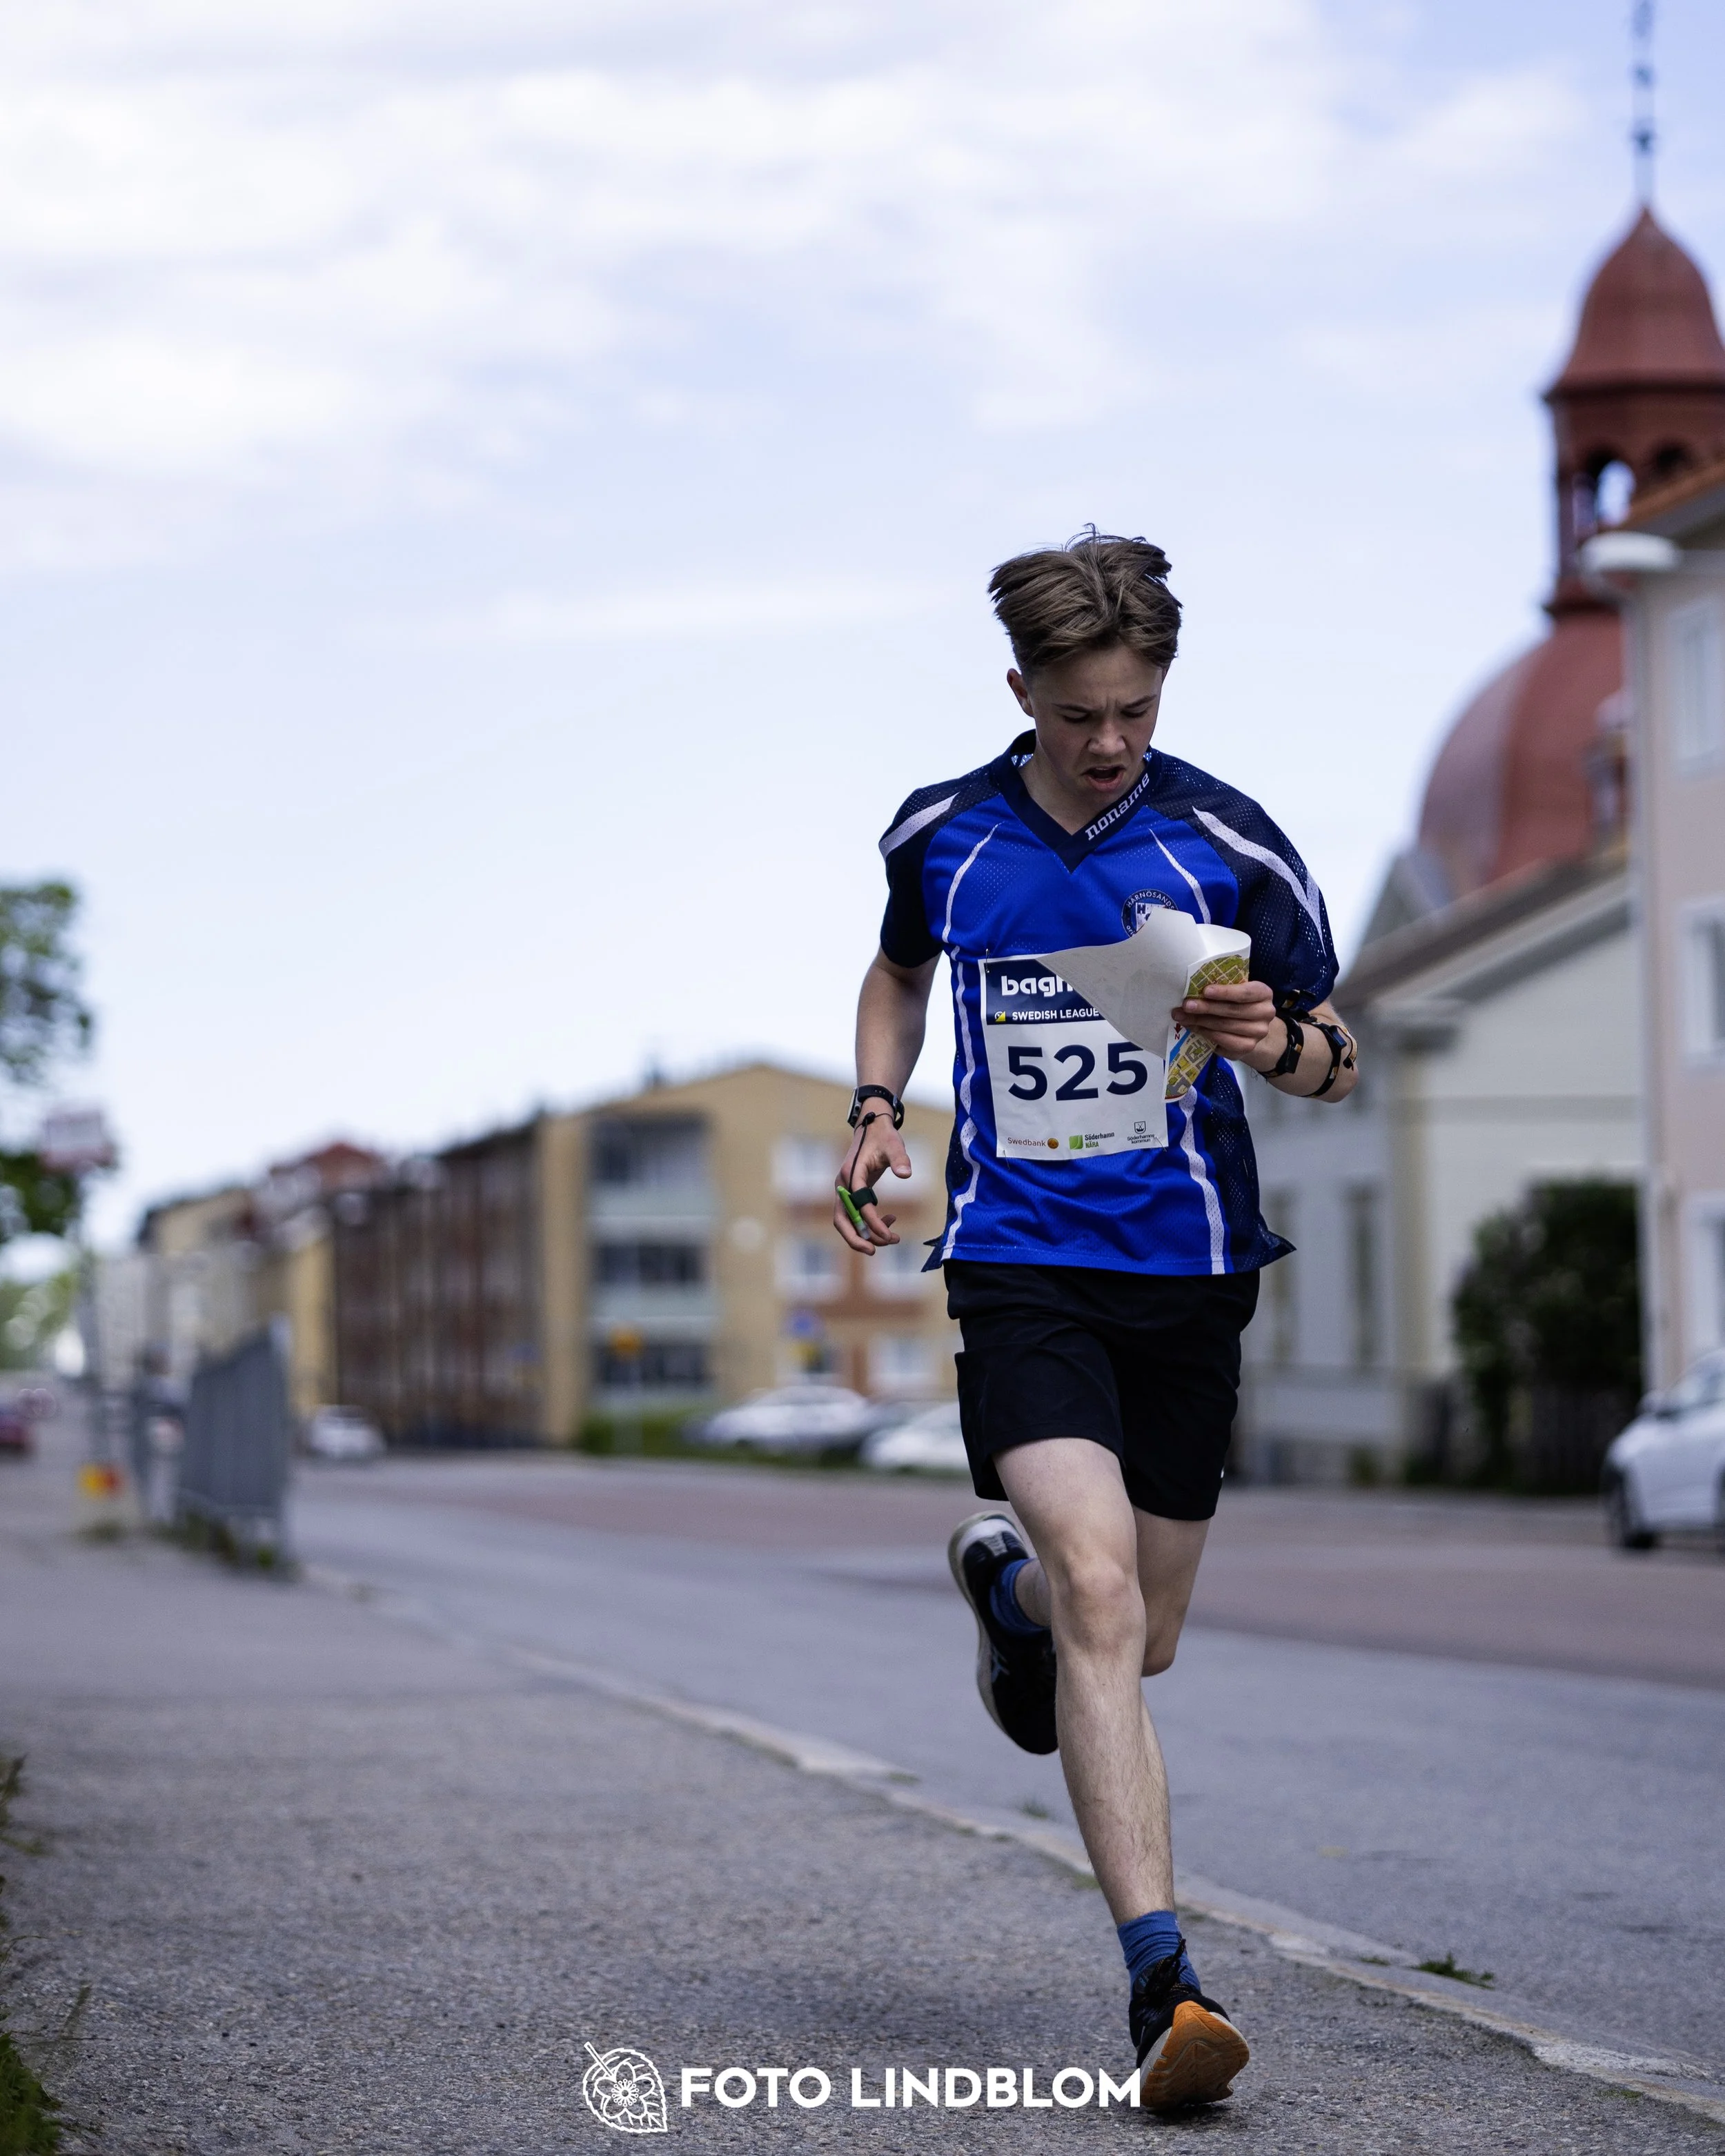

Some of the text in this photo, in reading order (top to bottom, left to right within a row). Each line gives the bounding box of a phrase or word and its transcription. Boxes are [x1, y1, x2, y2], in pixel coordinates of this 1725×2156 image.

[1085, 773, 1150, 840] noname
[1012, 1007, 1099, 1021] SWEDISH LEAGUE
[1007, 1042, 1148, 1101] 525
[1007, 1137, 1046, 1147] Swedbank
[1085, 1131, 1115, 1140] Söderhamn
